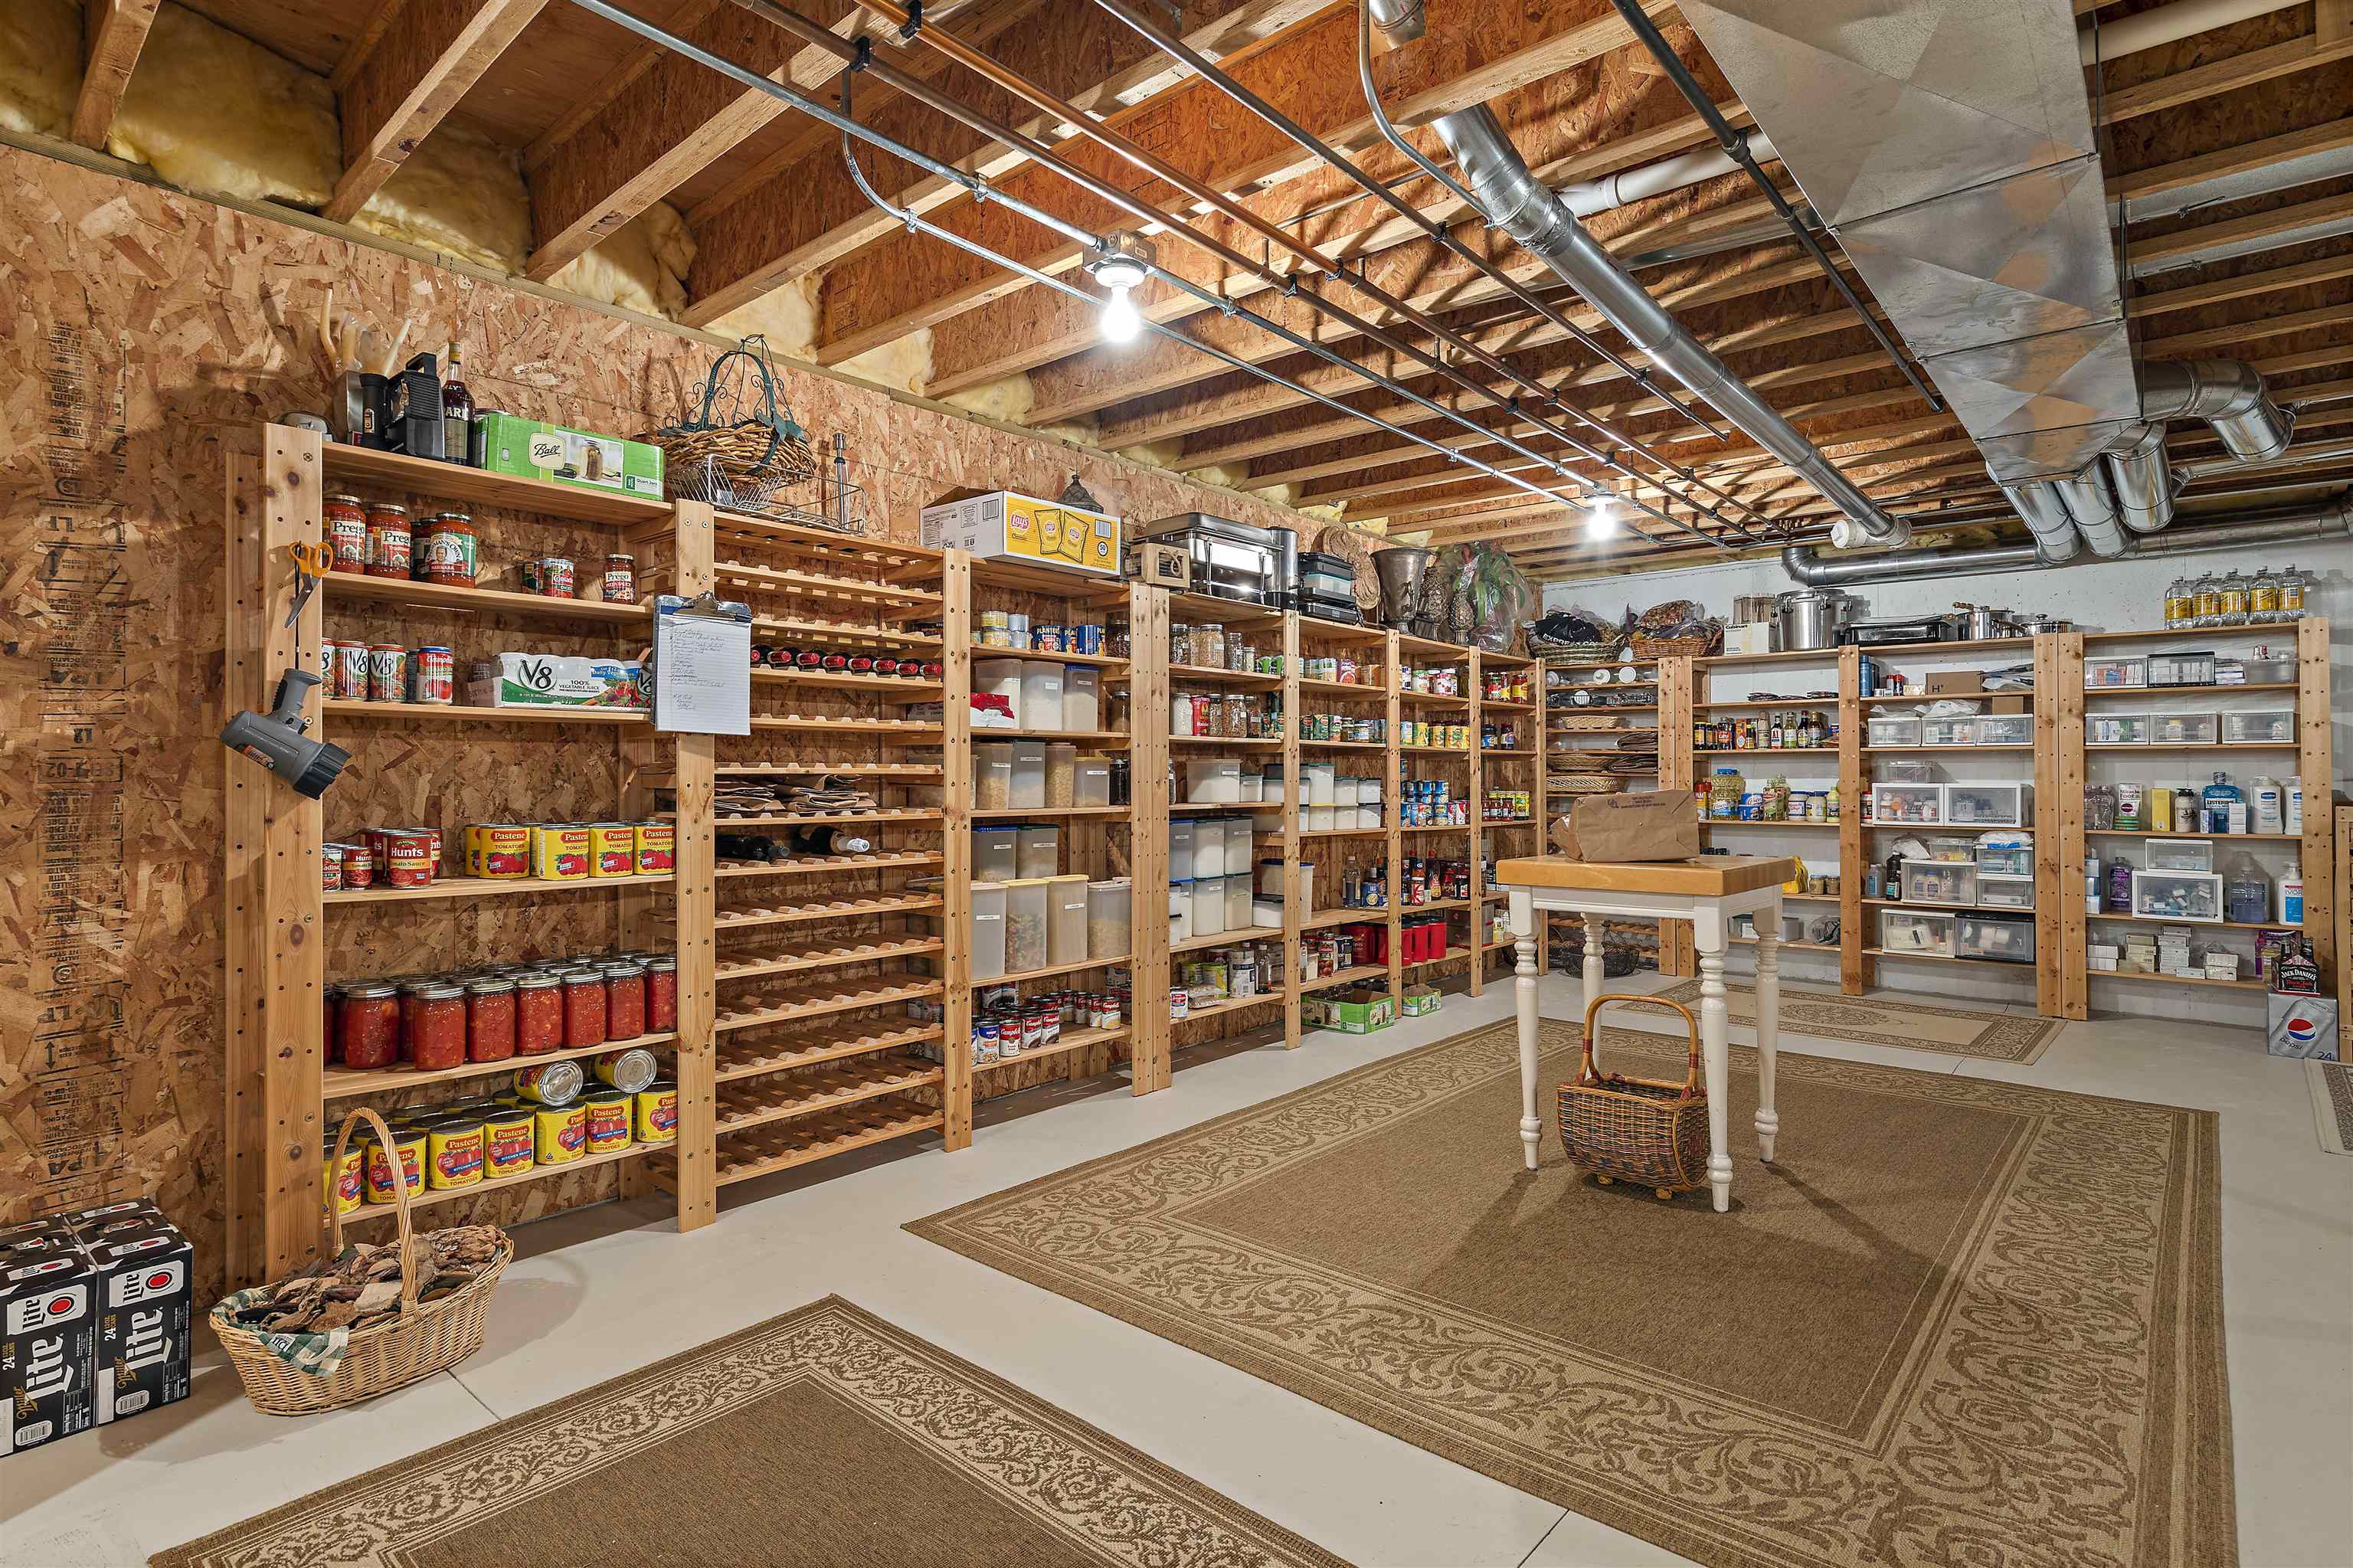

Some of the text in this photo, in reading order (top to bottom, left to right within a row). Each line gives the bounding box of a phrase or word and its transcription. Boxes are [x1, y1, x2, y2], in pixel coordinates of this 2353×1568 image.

[534, 444, 561, 458] Ball
[334, 522, 365, 537] Prego
[1037, 627, 1060, 635] PLANTERS
[370, 652, 394, 675] V8
[521, 659, 552, 689] V8
[495, 832, 525, 841] Pastene
[2281, 968, 2316, 980] JACK DANIEL'S
[2279, 1037, 2303, 1050] pepsi
[2317, 1051, 2332, 1060] 24
[594, 1108, 621, 1117] Pastene
[497, 1128, 528, 1138] Pastene
[450, 1137, 479, 1149] Pastene
[453, 1163, 470, 1172] KITCHEN
[498, 1165, 526, 1175] TOMATOES
[450, 1177, 478, 1187] TOMATOES
[123, 1272, 141, 1303] Lite
[22, 1298, 44, 1330] Lite
[104, 1326, 116, 1341] 24
[123, 1305, 174, 1370] Lite
[2, 1354, 15, 1370] 24
[24, 1333, 74, 1400] Lite
[115, 1357, 136, 1389] Miller
[15, 1385, 38, 1419] Miller
